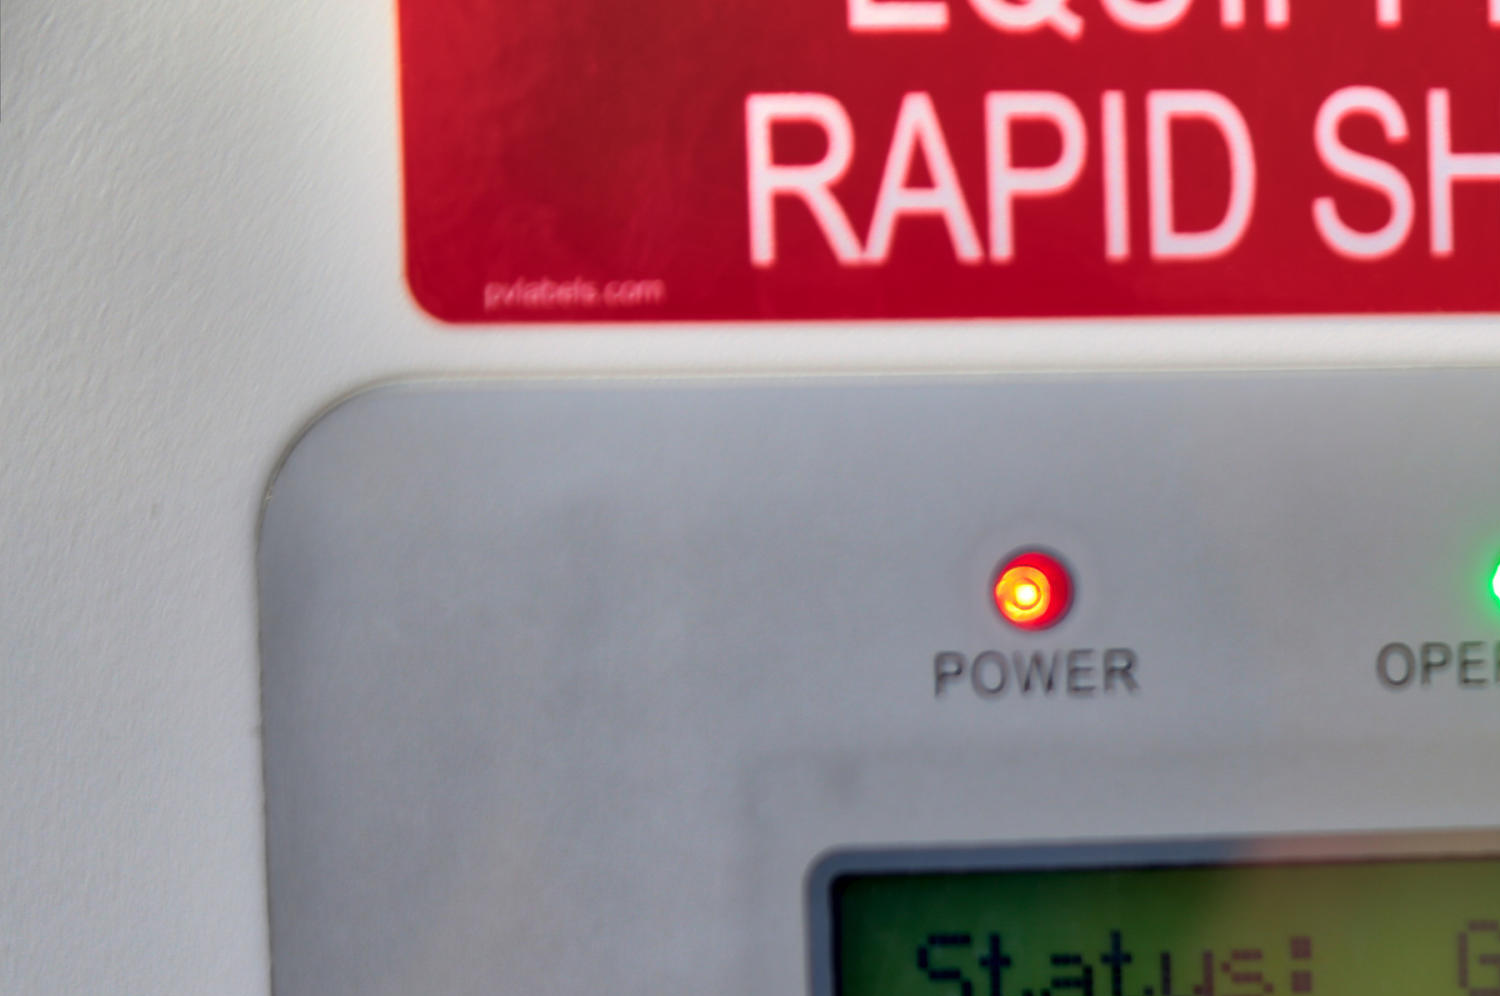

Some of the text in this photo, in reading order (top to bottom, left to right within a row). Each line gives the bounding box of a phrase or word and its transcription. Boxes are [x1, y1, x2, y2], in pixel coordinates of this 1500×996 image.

[745, 88, 1257, 267] RAPID
[484, 275, 666, 311] pvlabels.com
[932, 648, 1139, 698] POWER
